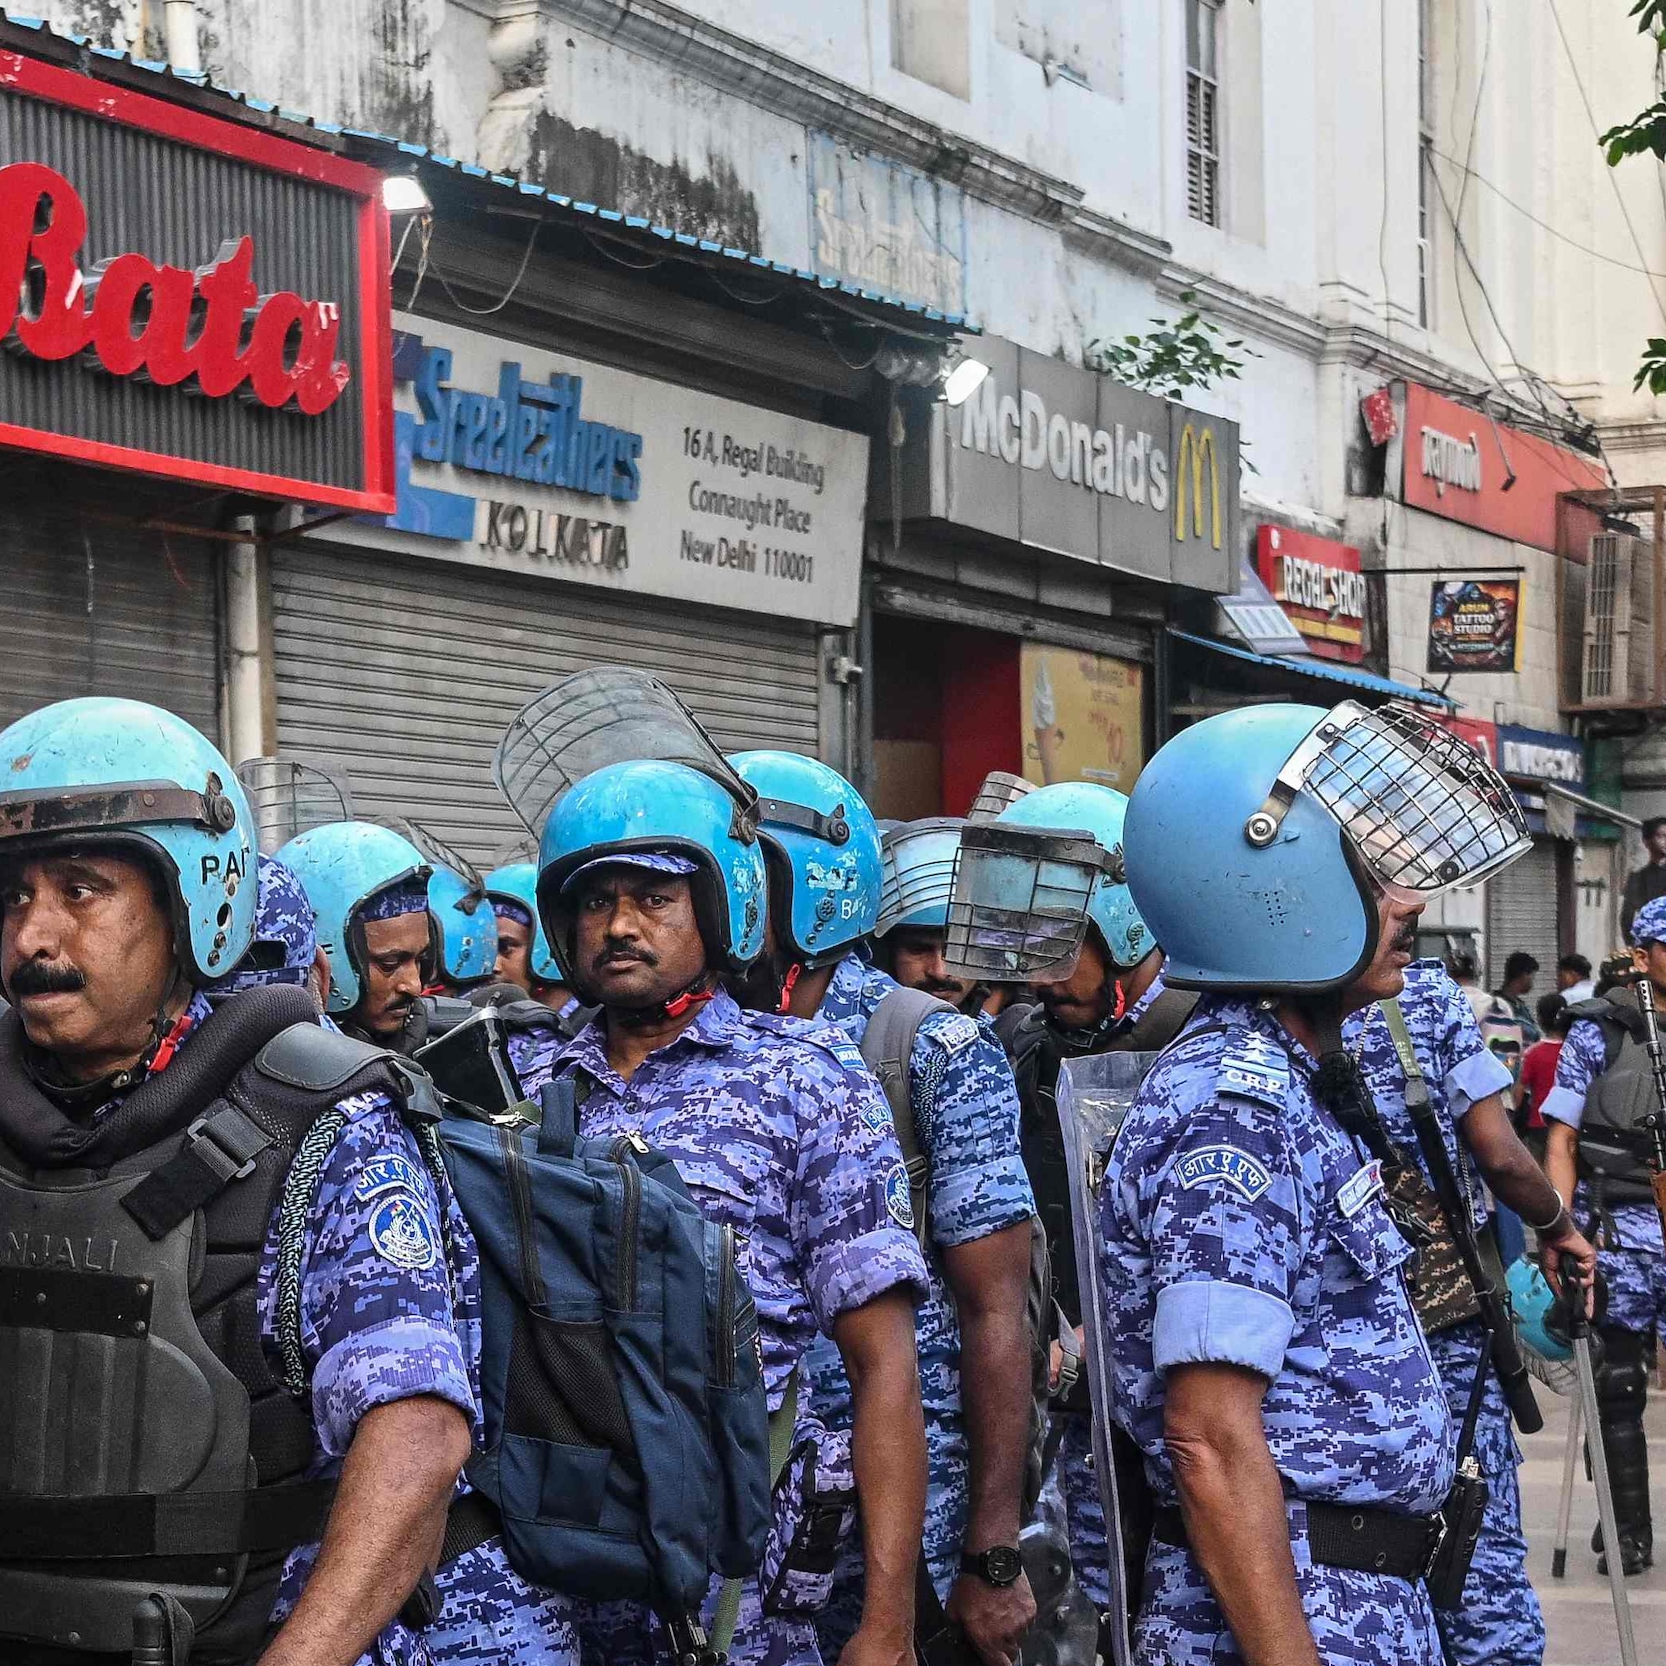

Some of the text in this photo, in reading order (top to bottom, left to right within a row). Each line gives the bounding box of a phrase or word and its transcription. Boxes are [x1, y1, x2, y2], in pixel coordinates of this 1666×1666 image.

[683, 427, 702, 459] 16
[722, 435, 765, 478] Regal
[766, 445, 825, 496] Building
[961, 375, 1169, 512] McDonald's
[689, 480, 812, 534] Connaught Place
[478, 501, 629, 569] KOLKATA
[680, 529, 715, 566] New
[717, 537, 757, 574] Delhi
[1454, 614, 1495, 624] TATTOO
[1454, 625, 1493, 634] STUDIO
